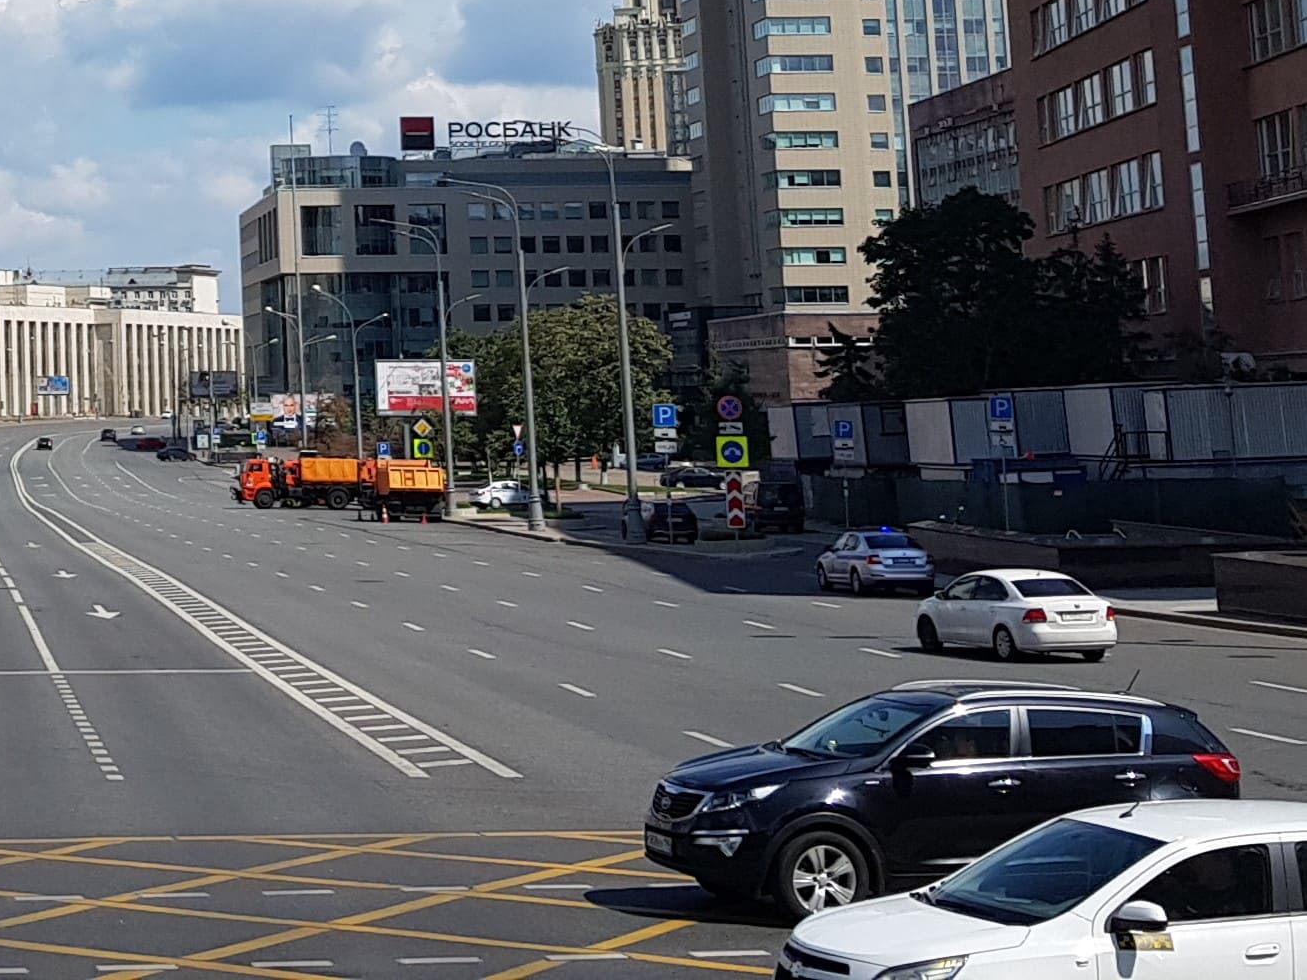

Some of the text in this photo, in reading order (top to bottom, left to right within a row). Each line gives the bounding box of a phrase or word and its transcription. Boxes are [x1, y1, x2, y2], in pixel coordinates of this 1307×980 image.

[448, 121, 572, 138] РОСБАНК
[658, 406, 672, 424] P
[996, 399, 1008, 417] P
[839, 421, 851, 437] P
[379, 443, 387, 454] P
